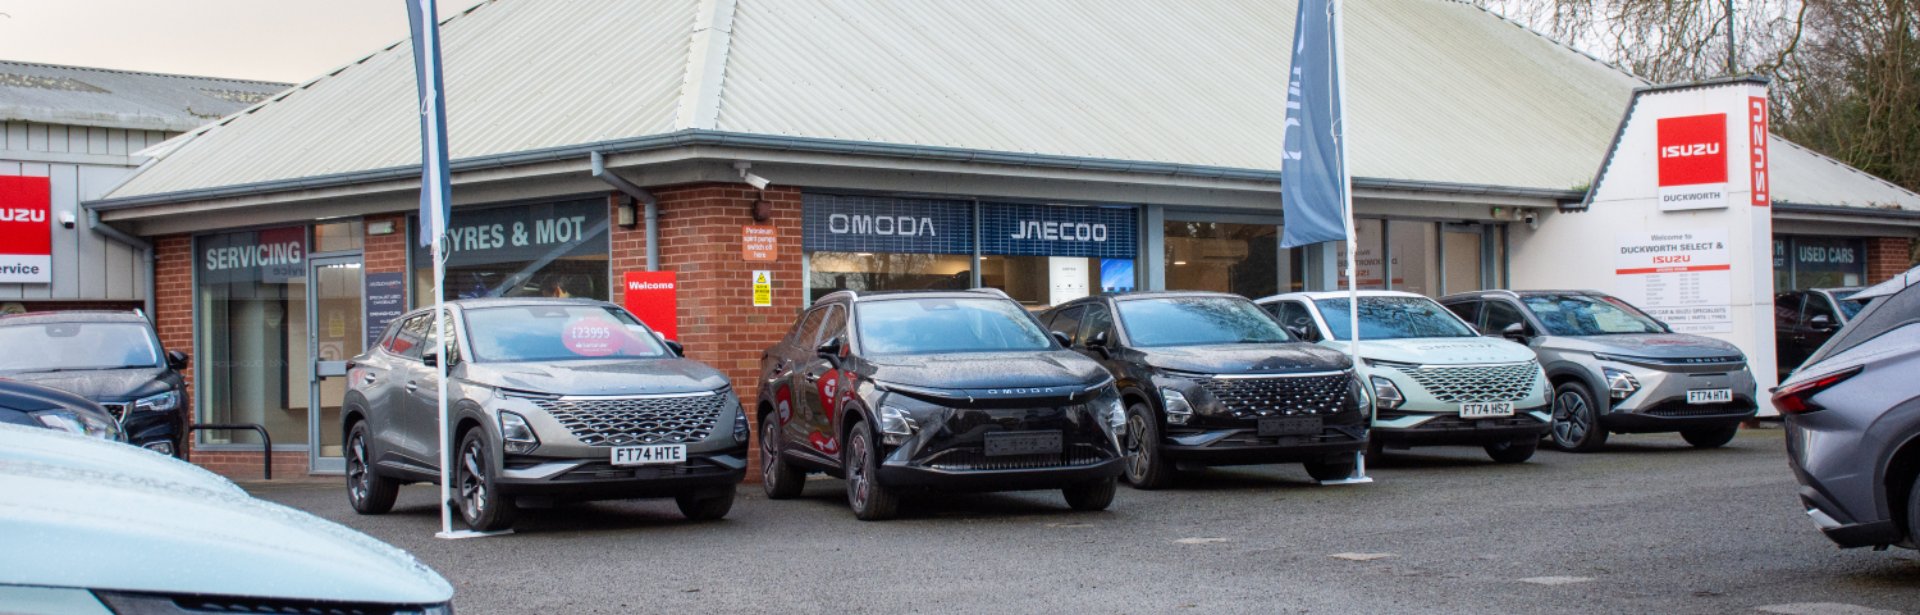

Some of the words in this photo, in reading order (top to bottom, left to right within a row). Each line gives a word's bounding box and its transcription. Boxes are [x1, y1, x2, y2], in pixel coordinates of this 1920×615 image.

[1662, 142, 1719, 158] ISUZU
[1753, 101, 1766, 202] ISUZU
[1664, 192, 1721, 202] DUCKWORTH
[0, 208, 45, 222] UZU
[511, 221, 529, 247] &
[535, 215, 586, 244] MOT
[828, 213, 936, 236] OMODA
[1011, 220, 1107, 241] JAECOO
[1621, 244, 1678, 254] DUCKWORTH
[1680, 242, 1713, 252] SELECT
[1716, 241, 1724, 250] &
[1799, 245, 1826, 262] USED
[1828, 247, 1854, 264] CARS
[206, 241, 301, 271] SERVICING
[1652, 255, 1691, 264] ISUZU
[0, 262, 40, 274] rvice
[629, 281, 674, 290] Welcome
[1691, 391, 1712, 401] FT74
[1713, 390, 1729, 400] HTA
[1463, 404, 1489, 415] FT74
[1491, 402, 1510, 414] HSZ
[616, 447, 652, 462] FT74
[654, 446, 681, 460] HTE
